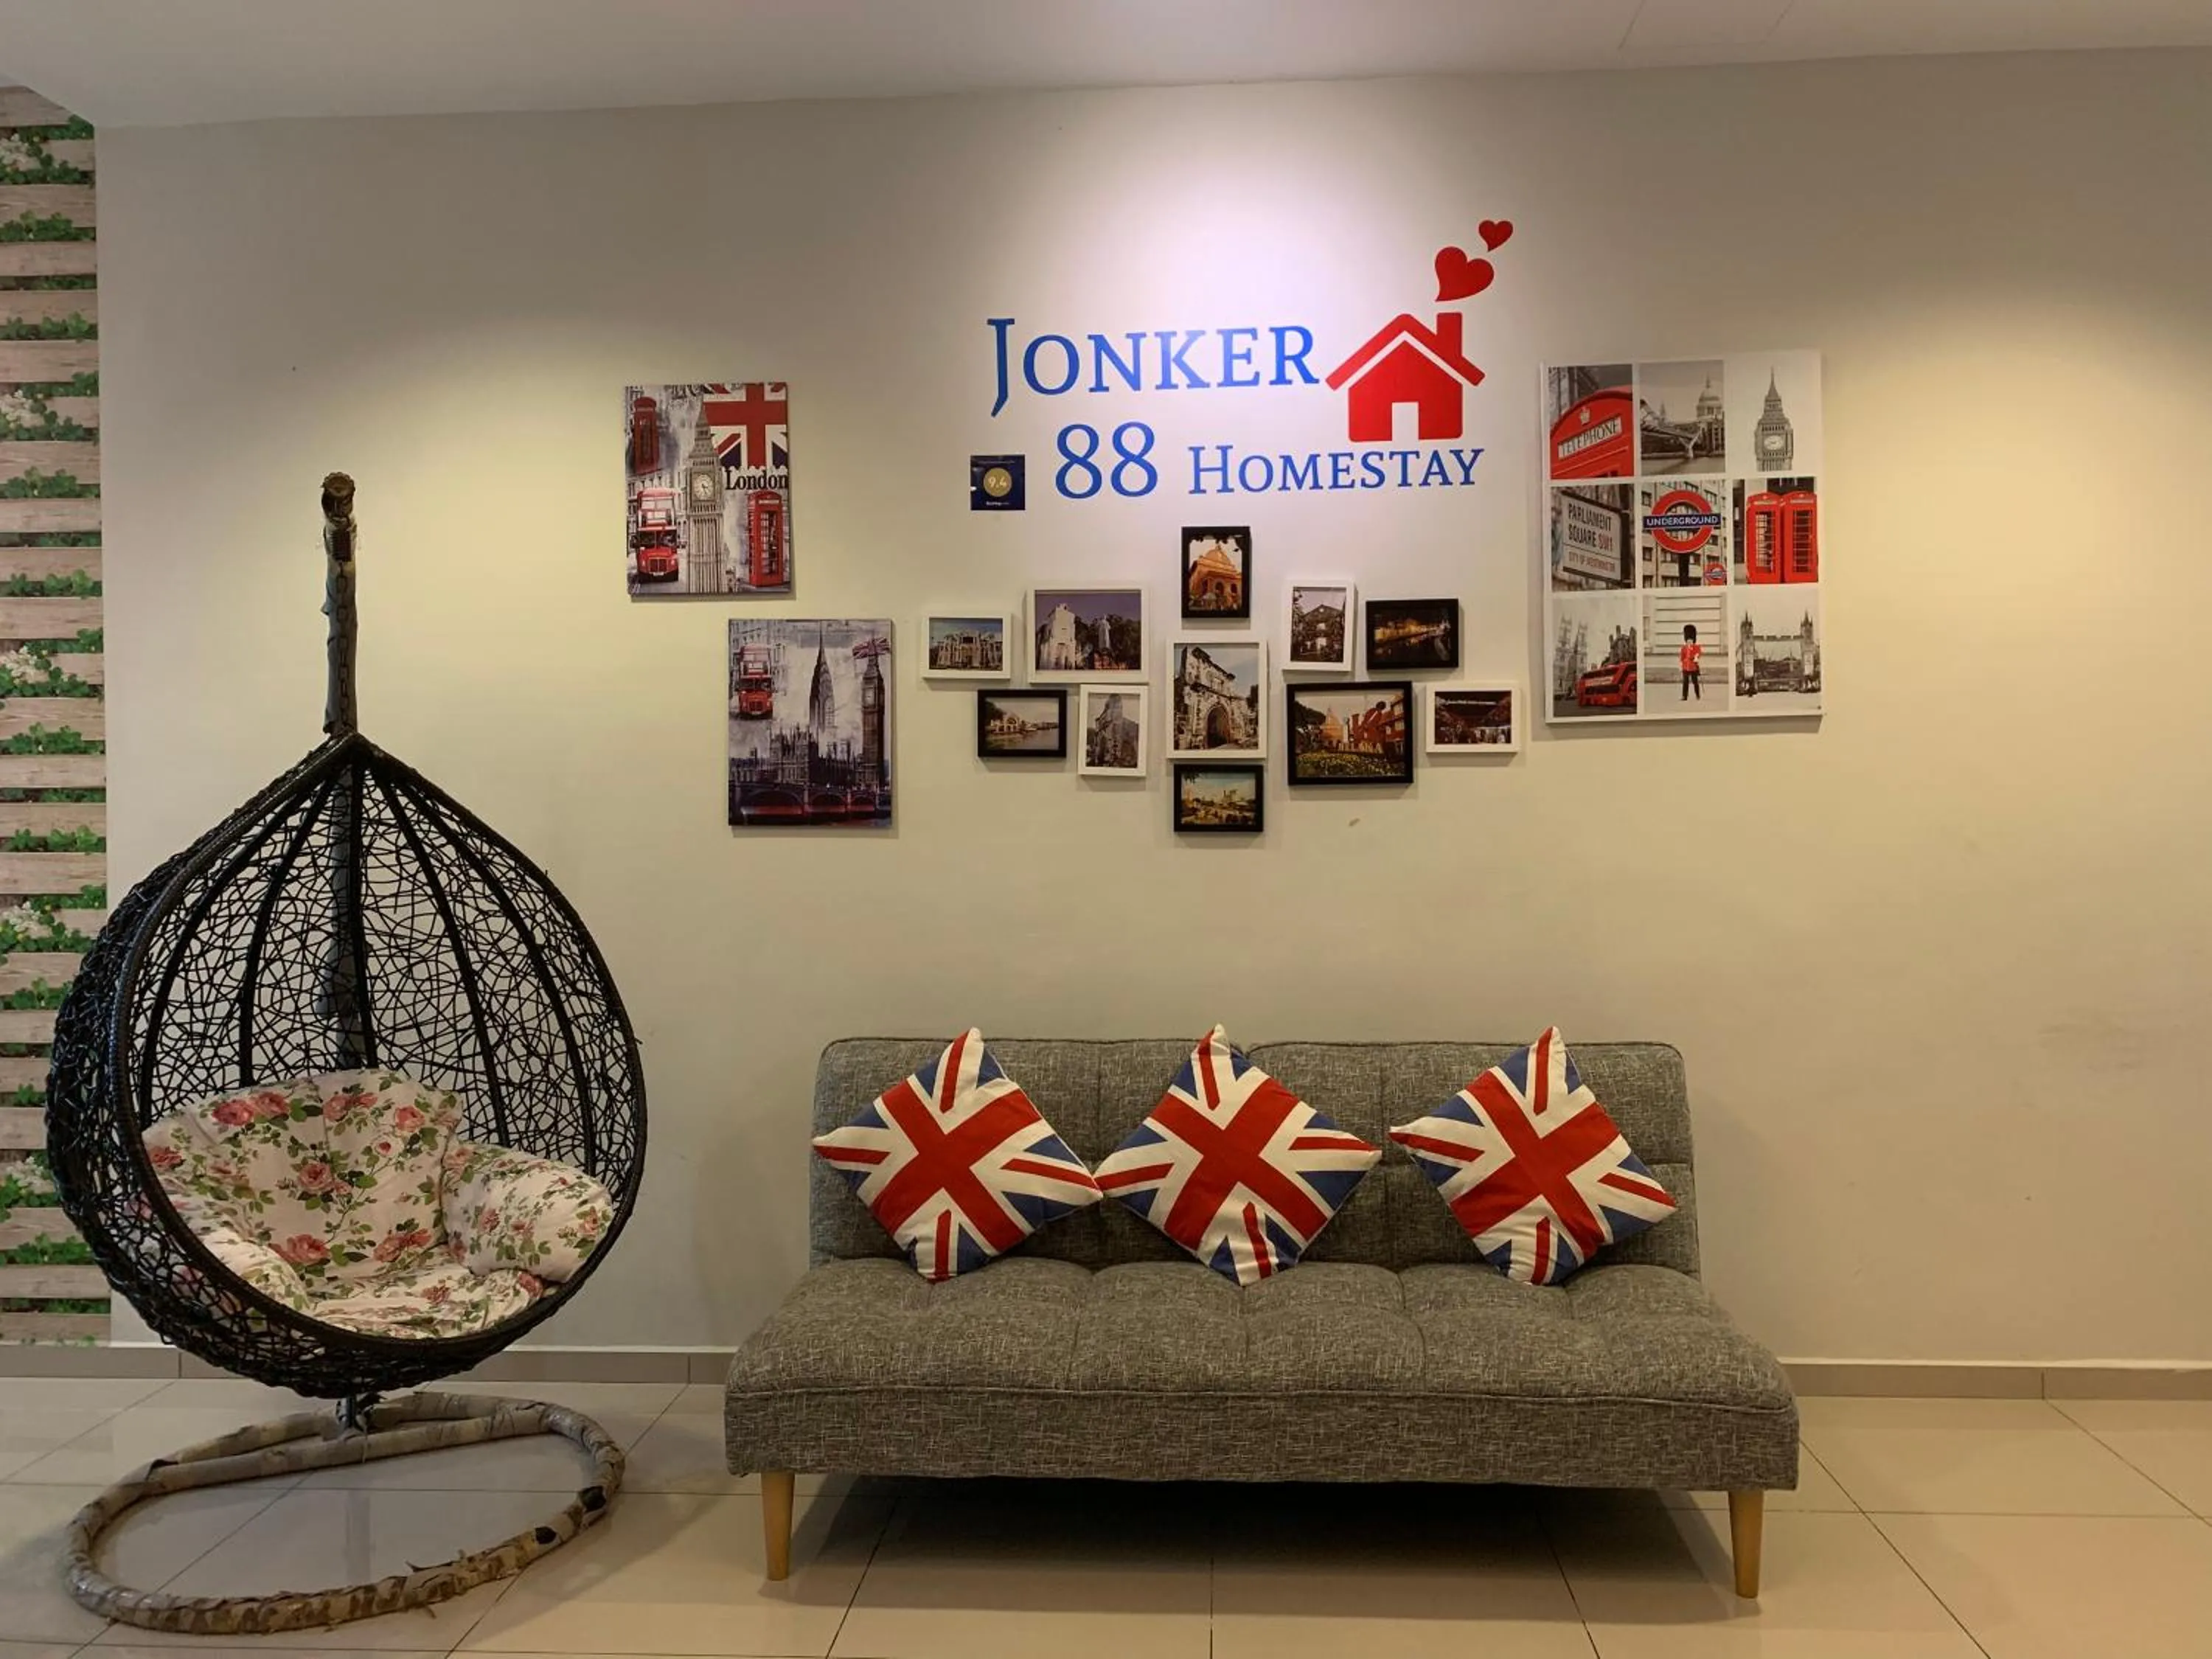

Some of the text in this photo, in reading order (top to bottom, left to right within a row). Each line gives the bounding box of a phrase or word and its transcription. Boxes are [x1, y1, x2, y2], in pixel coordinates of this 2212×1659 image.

[987, 318, 1320, 417] JONKER
[1055, 421, 1484, 498] 88 HOMESTAY
[725, 469, 788, 490] London
[1646, 515, 1718, 526] UNDERGROUND
[1568, 524, 1596, 548] SQUARE
